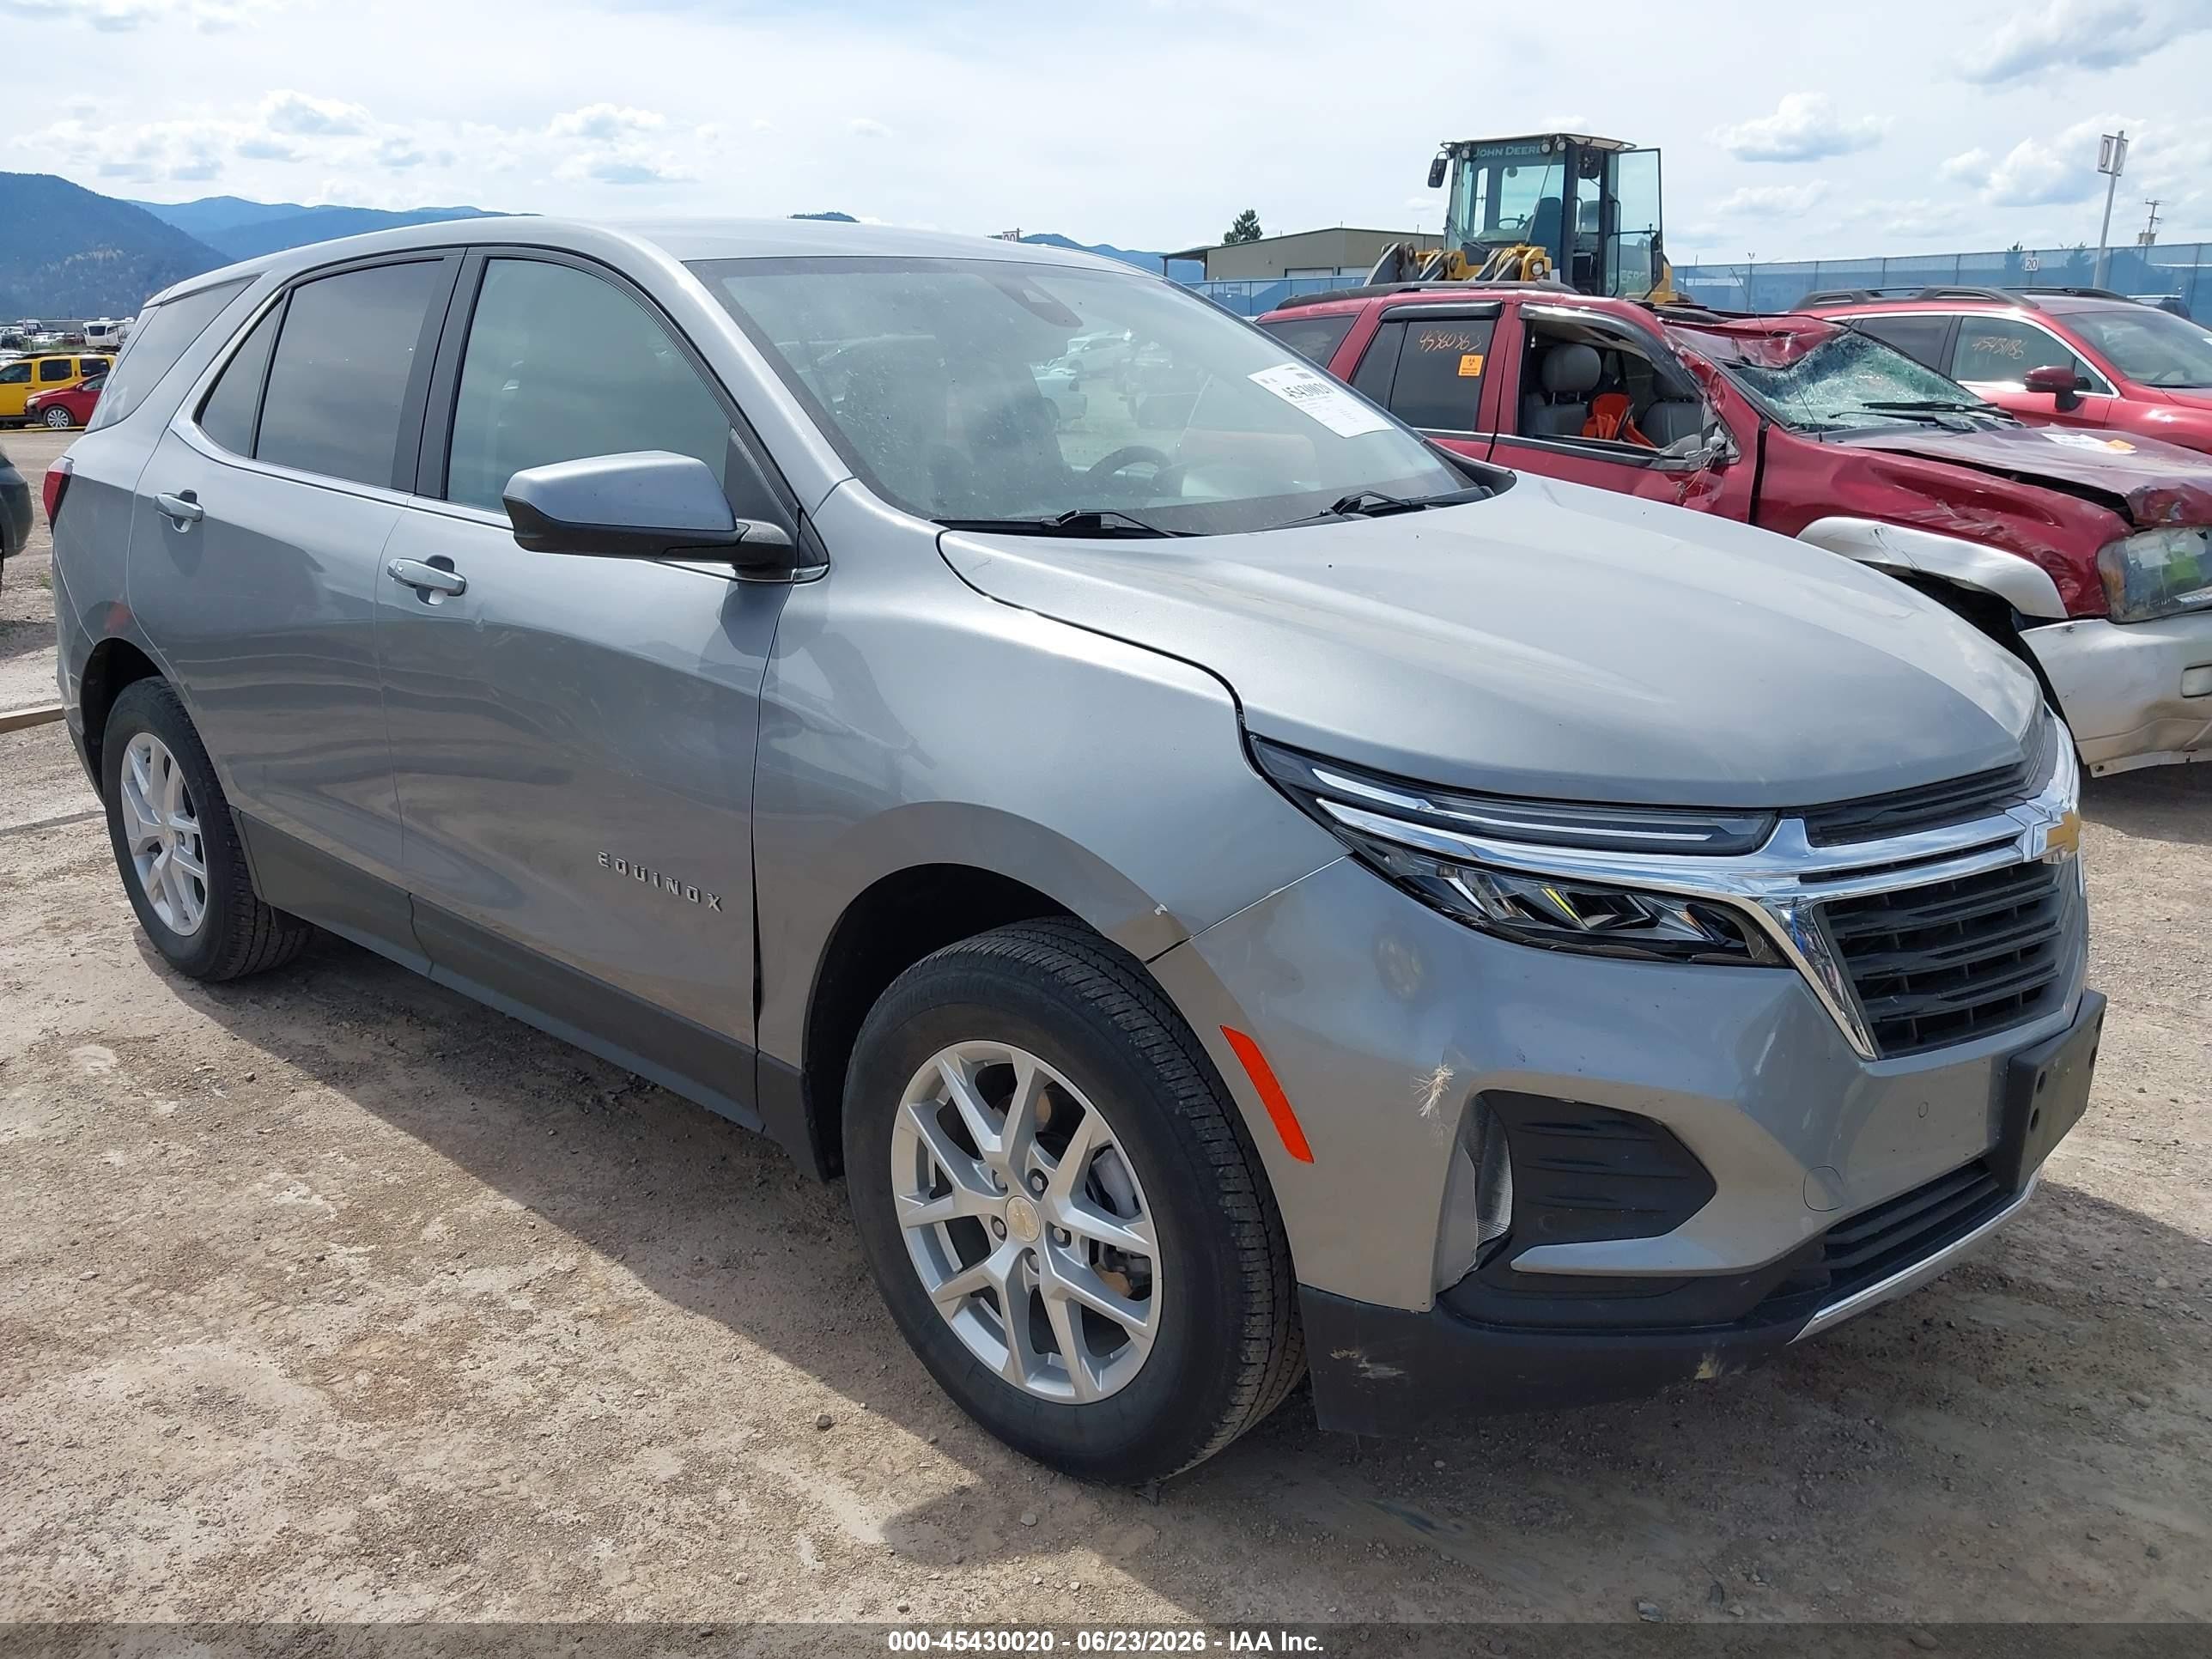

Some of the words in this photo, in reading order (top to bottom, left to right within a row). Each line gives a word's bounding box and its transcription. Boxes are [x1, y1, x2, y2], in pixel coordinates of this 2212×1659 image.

[1474, 148, 1504, 157] JOHN
[2101, 139, 2109, 167] D
[2027, 259, 2038, 270] 20
[598, 851, 722, 913] EQUINOX
